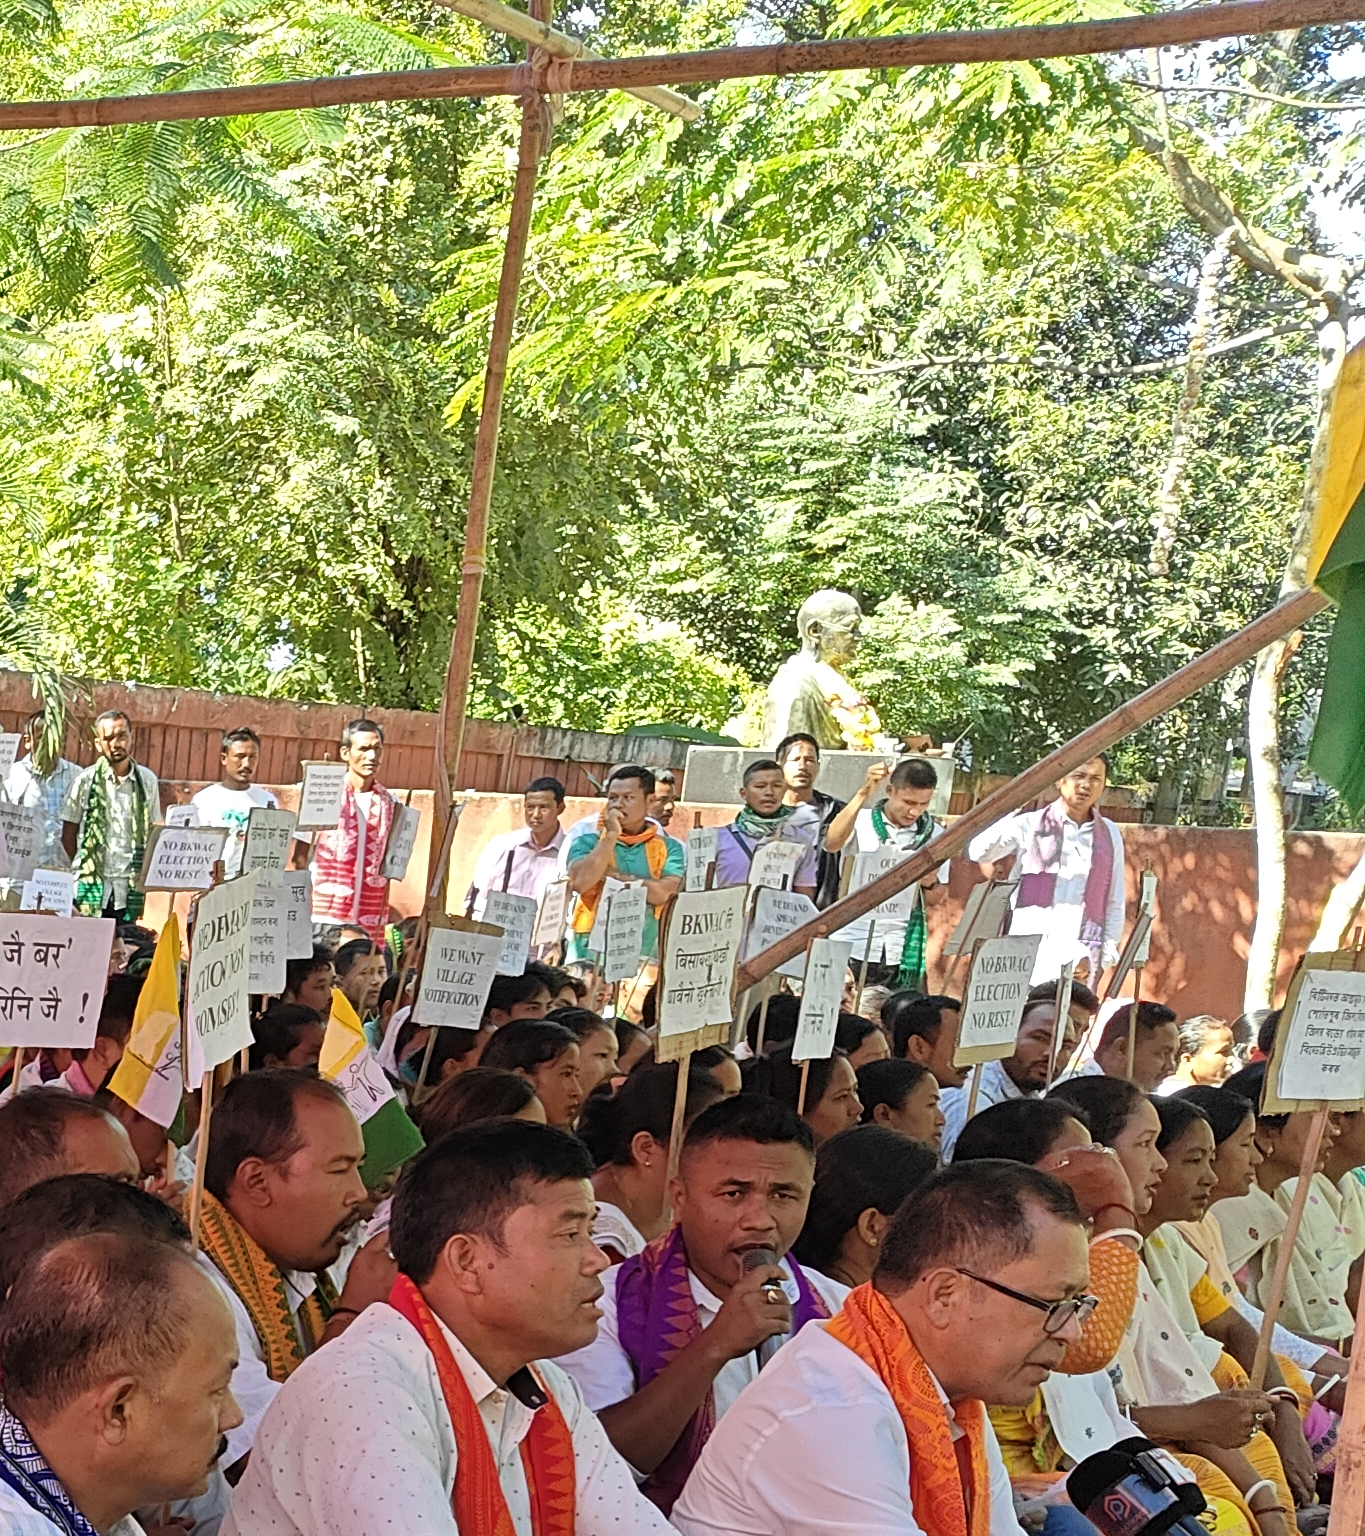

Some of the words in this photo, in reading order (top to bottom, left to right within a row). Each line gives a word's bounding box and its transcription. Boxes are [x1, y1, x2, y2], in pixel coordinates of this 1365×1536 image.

[160, 840, 178, 851] NO
[157, 854, 212, 866] ELECTION
[155, 869, 173, 879] NO
[2, 930, 25, 967] जै
[977, 957, 995, 974] NO
[995, 955, 1032, 974] BKWAC
[973, 984, 1023, 1002] ELECTION
[39, 986, 62, 1023] जै
[970, 1012, 986, 1029] NO
